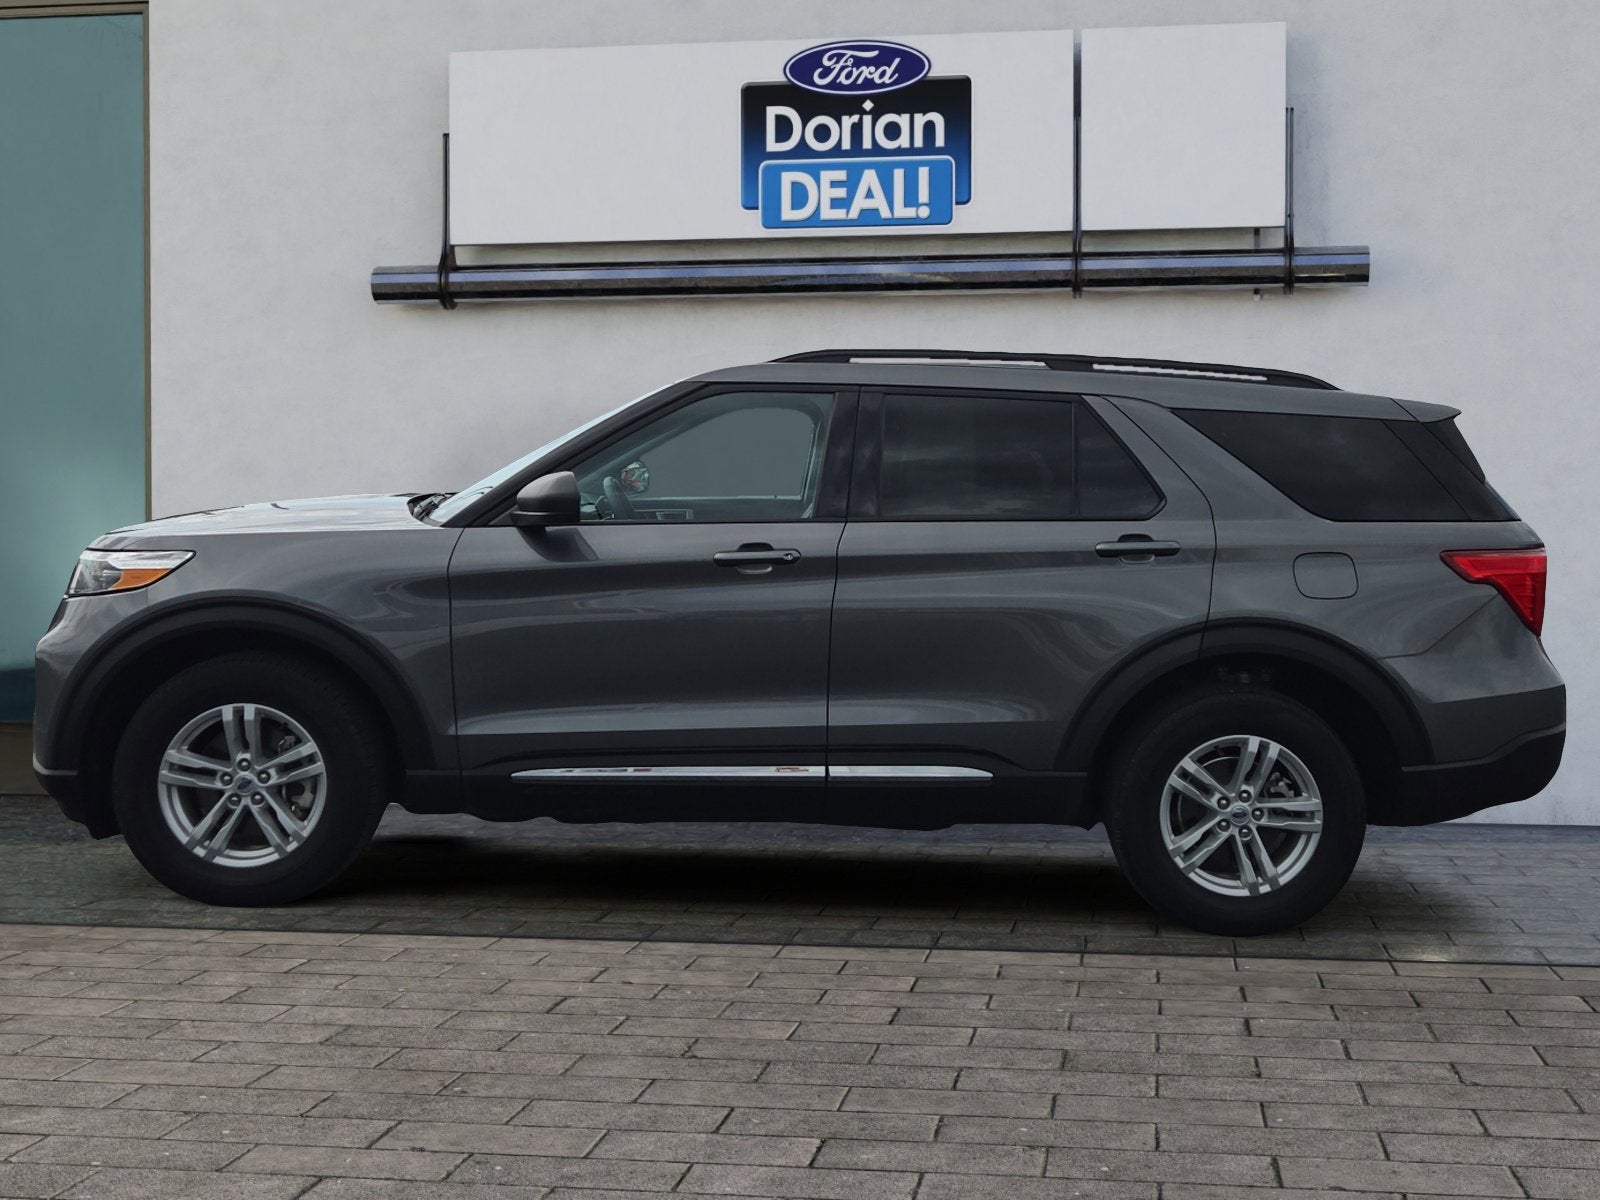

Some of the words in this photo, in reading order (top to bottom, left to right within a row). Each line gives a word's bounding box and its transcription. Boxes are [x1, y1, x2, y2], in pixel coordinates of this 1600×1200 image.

[813, 49, 902, 86] Ford
[766, 99, 945, 152] Dorian
[781, 166, 930, 221] DEAL!
